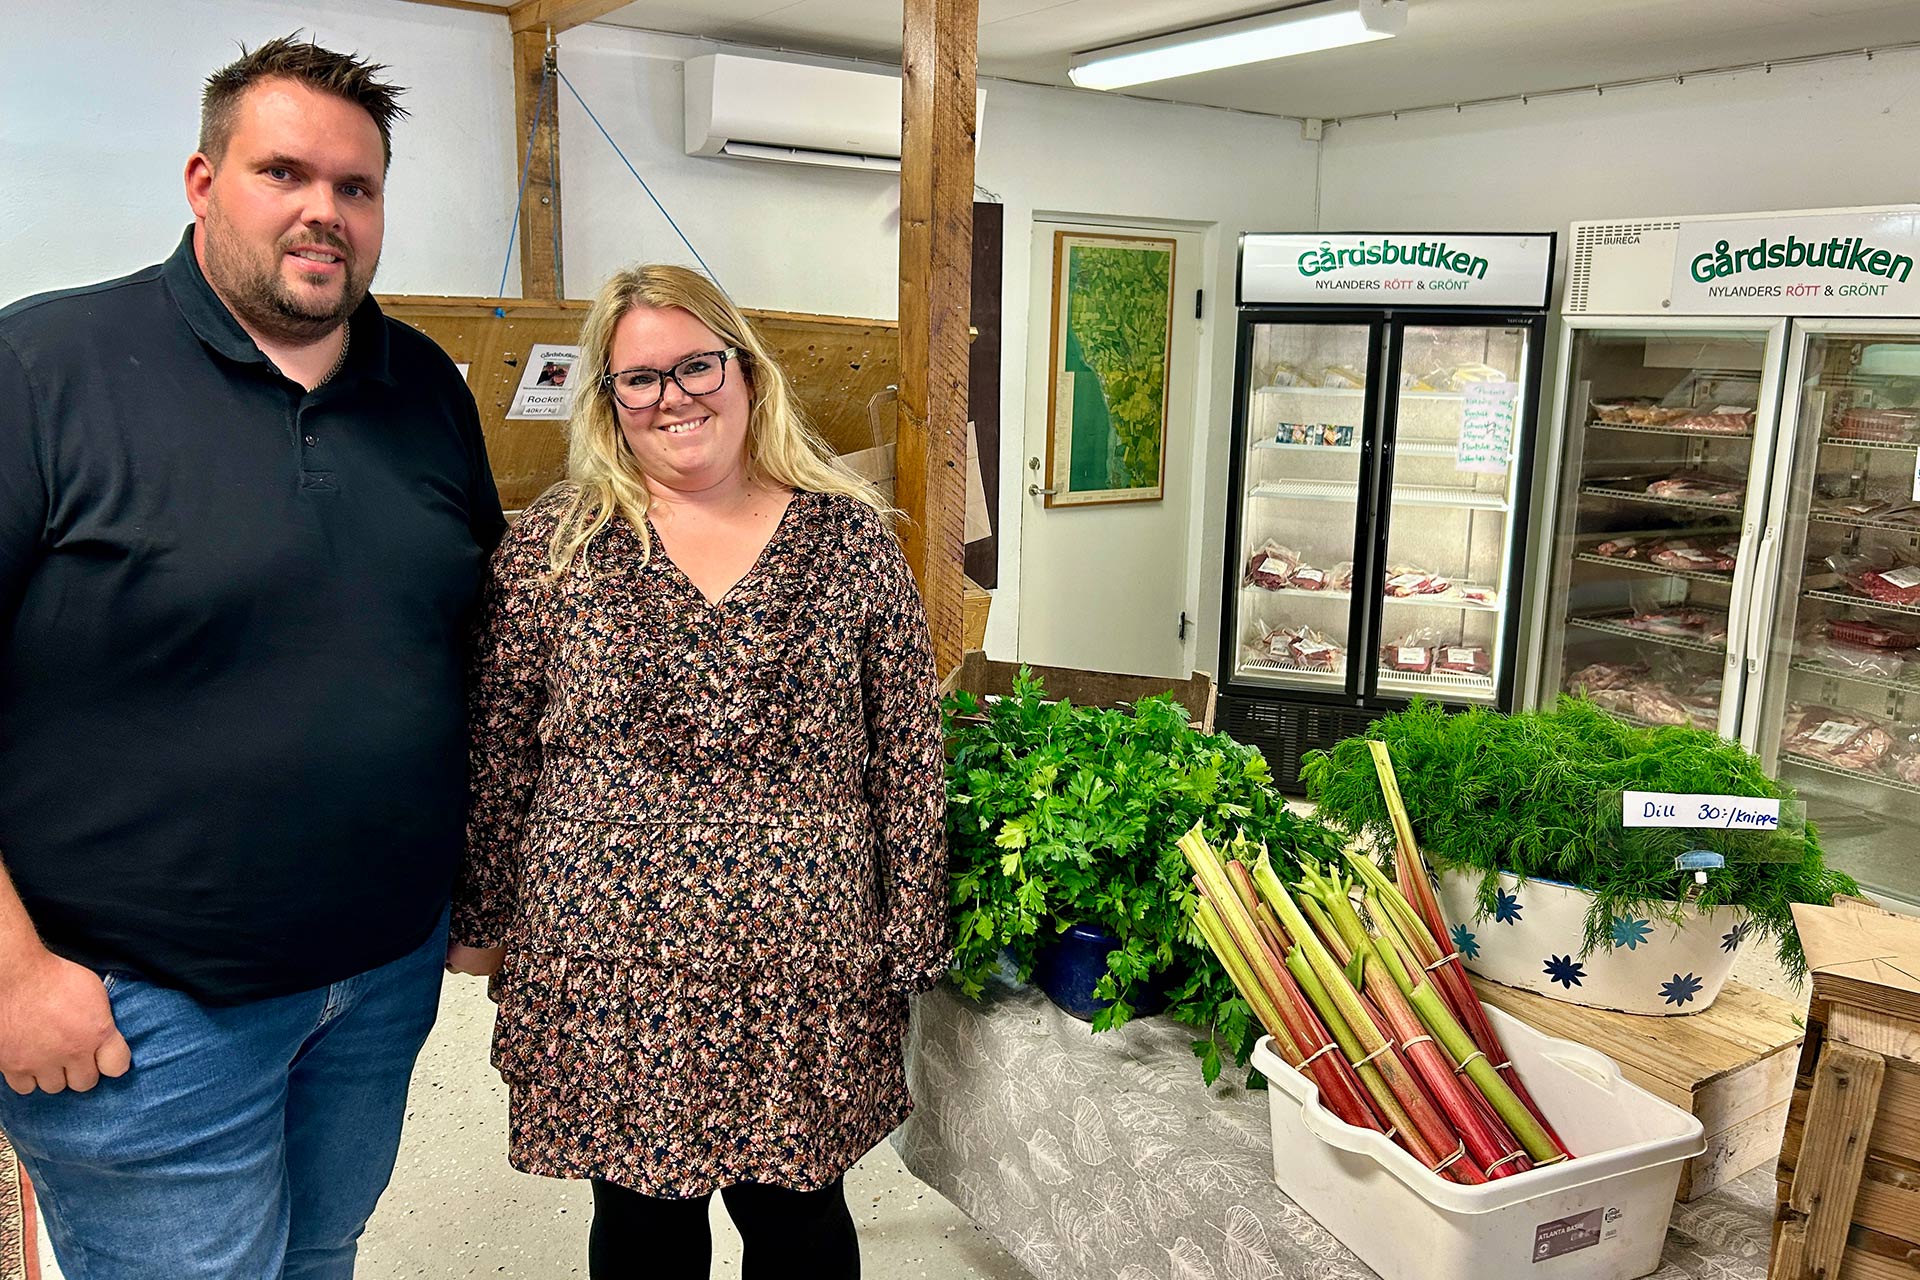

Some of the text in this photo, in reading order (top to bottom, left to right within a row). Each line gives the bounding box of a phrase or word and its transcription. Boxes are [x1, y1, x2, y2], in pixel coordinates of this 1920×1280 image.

[1297, 240, 1489, 279] Gårdsbutiken
[1690, 235, 1914, 284] Gårdsbutiken
[1315, 279, 1470, 291] NYLANDERS RÖTT & GRÖNT
[1708, 284, 1889, 297] NYLANDERS RÖTT & GRÖNT
[1643, 802, 1676, 818] Dill
[1538, 1228, 1566, 1241] ATLANTA
